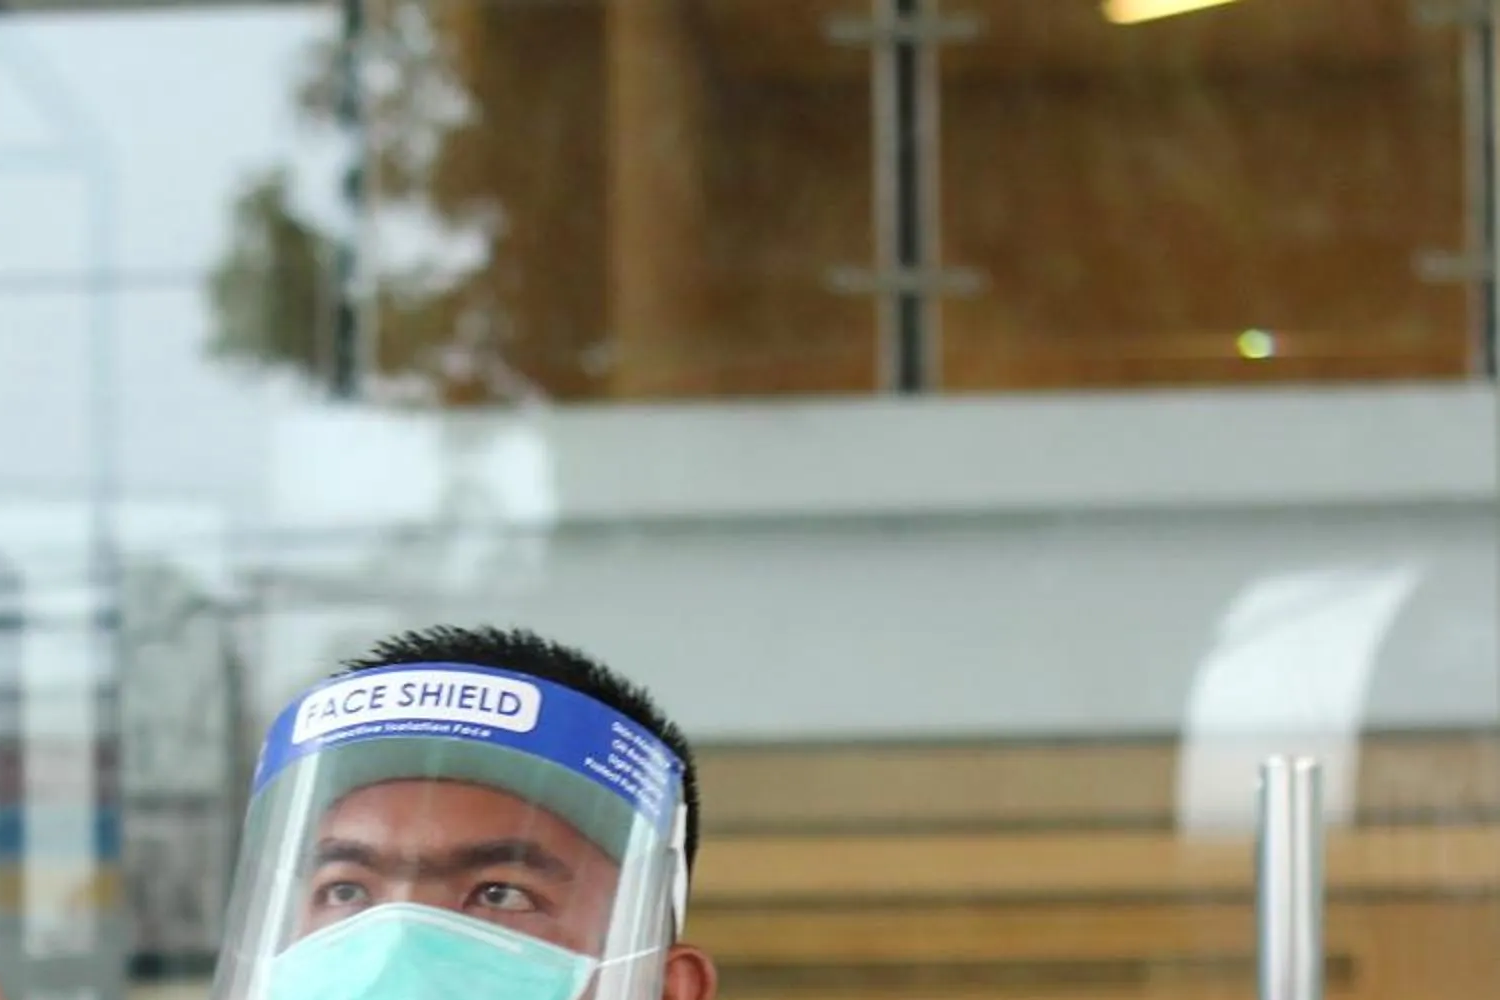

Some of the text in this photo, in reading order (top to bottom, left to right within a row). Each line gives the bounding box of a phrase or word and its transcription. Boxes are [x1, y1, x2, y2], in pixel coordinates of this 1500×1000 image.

[305, 682, 522, 728] FACE SHIELD
[451, 723, 492, 737] Face
